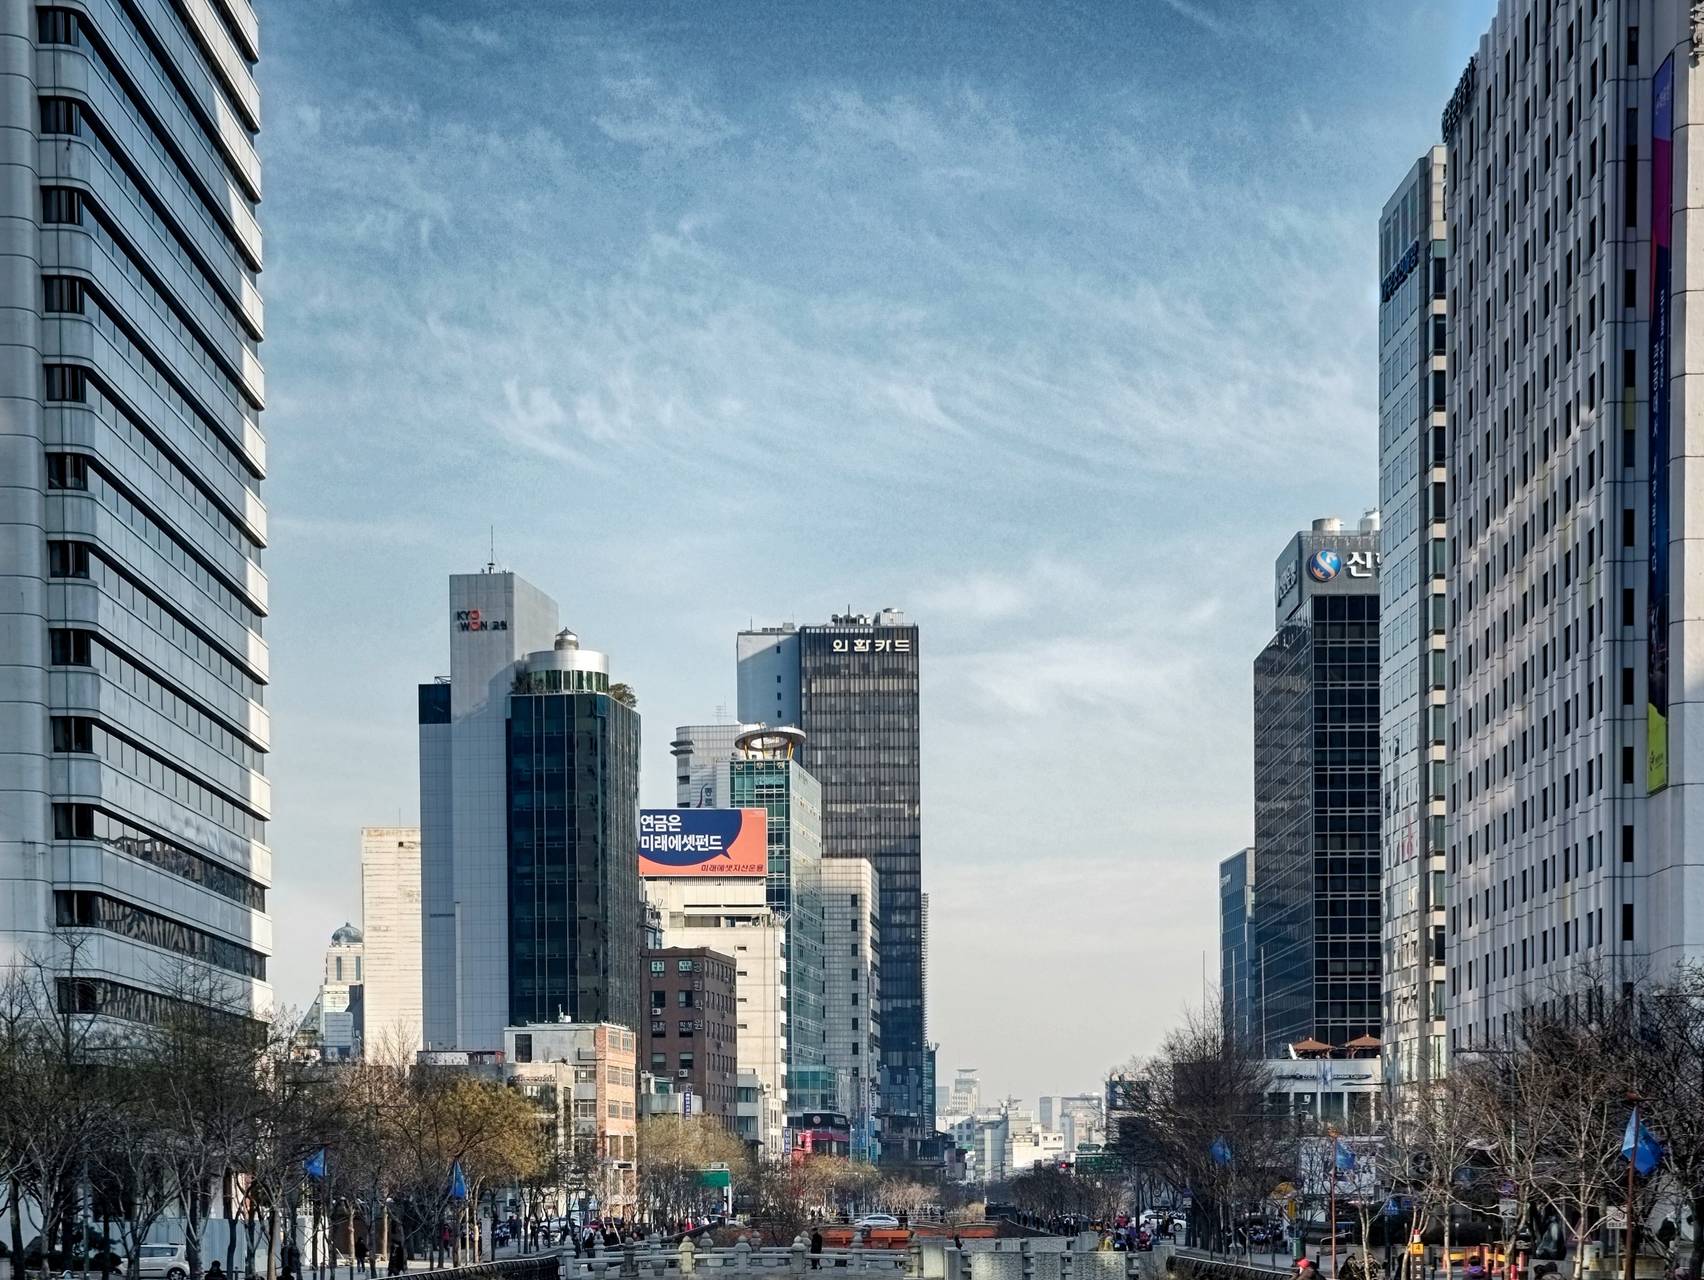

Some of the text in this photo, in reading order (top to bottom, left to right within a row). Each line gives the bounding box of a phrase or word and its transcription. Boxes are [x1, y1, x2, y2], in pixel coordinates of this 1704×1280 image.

[456, 610, 480, 621] KYO
[460, 620, 488, 631] WON
[640, 814, 682, 832] 연금은
[641, 834, 723, 852] 미래에셋펀드
